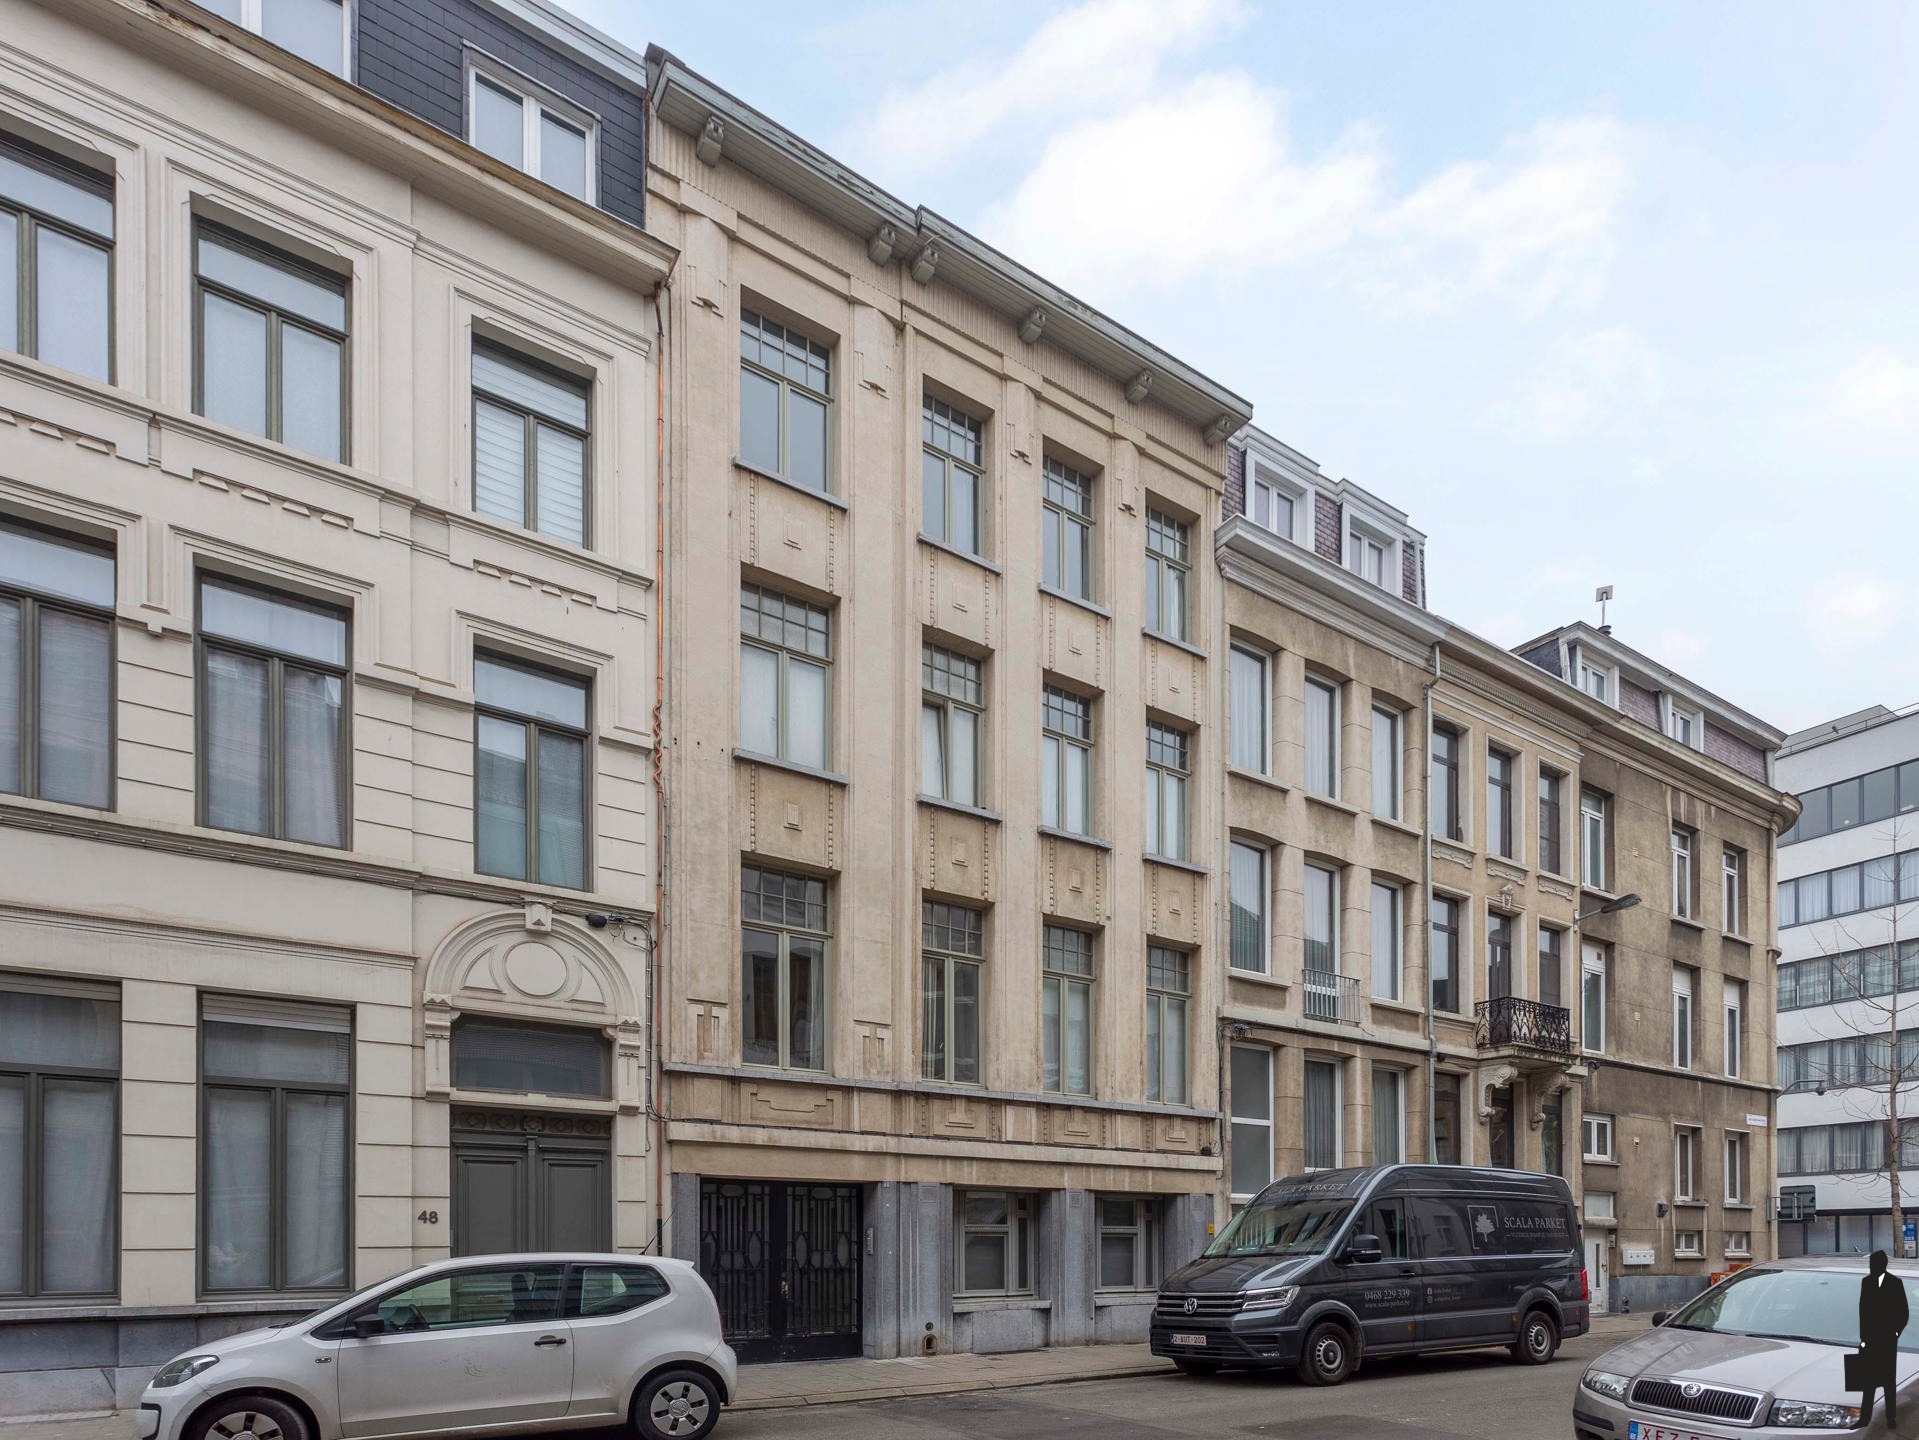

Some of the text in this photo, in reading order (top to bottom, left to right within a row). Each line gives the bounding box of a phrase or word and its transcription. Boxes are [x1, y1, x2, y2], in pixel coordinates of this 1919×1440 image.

[417, 1210, 439, 1225] 48
[1503, 1216, 1566, 1229] SCALA PARKET
[1364, 1289, 1382, 1301] 0468
[1384, 1289, 1397, 1299] 229
